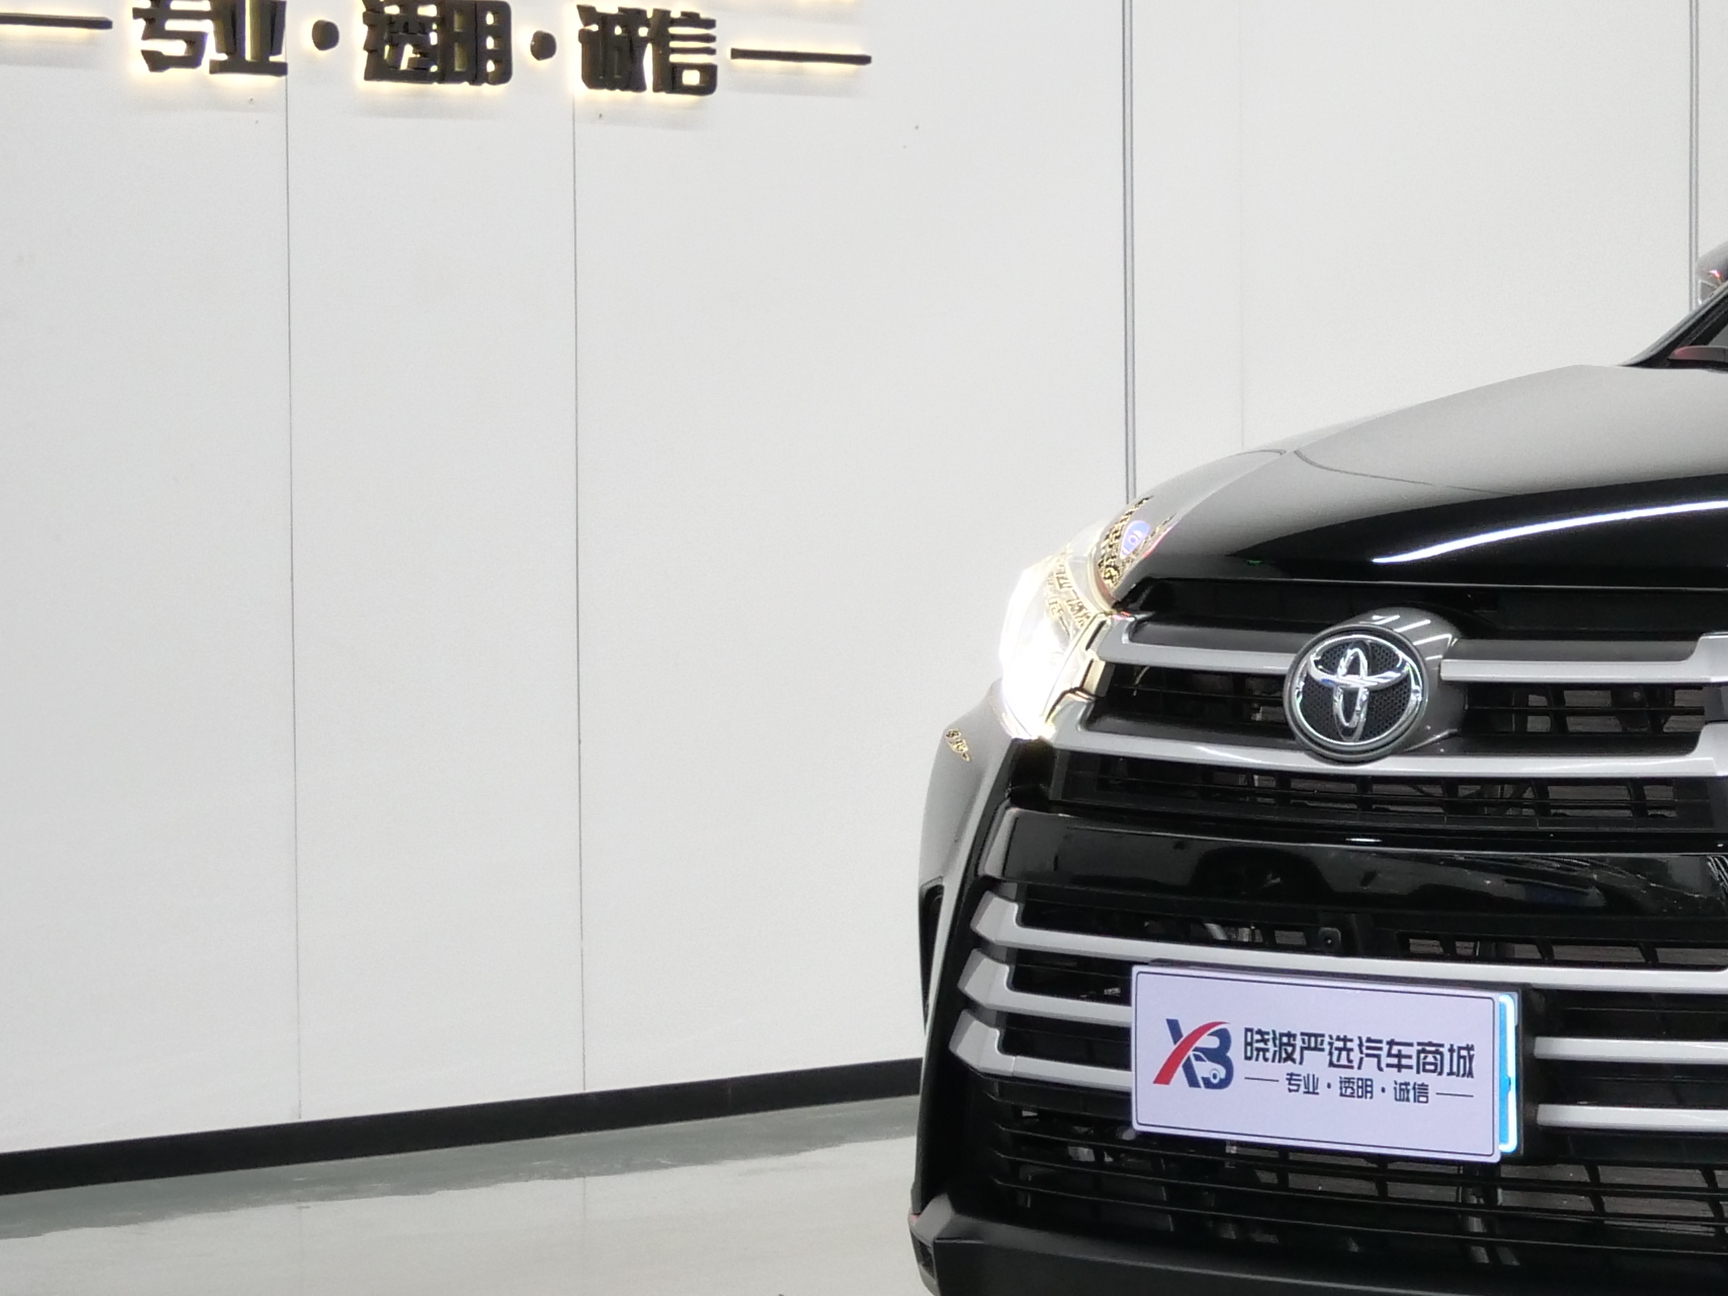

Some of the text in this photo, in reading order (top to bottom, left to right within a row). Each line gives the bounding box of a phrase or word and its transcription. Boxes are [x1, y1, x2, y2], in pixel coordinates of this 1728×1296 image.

[1244, 1027, 1475, 1079] 晓波严选汽车商城
